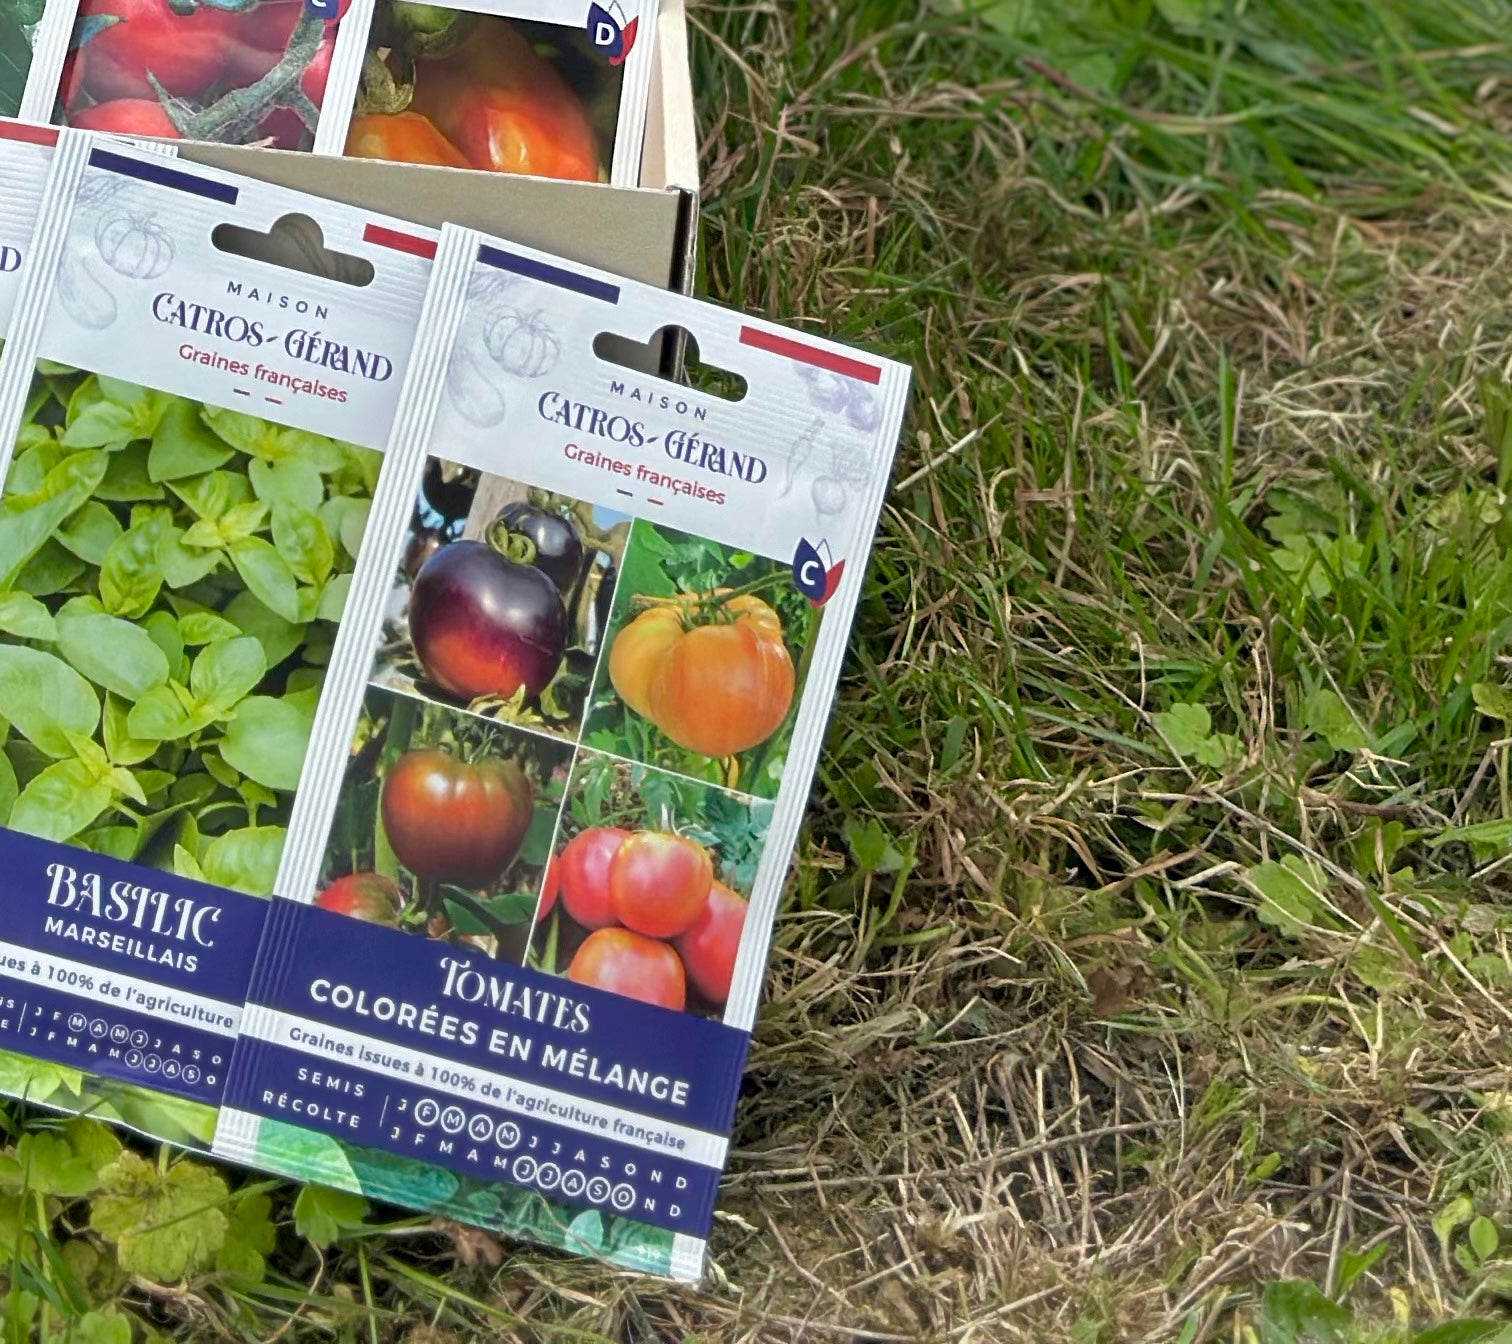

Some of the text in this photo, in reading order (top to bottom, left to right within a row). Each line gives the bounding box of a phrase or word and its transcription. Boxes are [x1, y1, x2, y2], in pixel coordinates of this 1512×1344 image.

[595, 22, 615, 46] D
[227, 281, 328, 319] MAISON
[179, 344, 348, 403] Graines françaises
[610, 381, 707, 421] MAISON
[564, 444, 726, 505] Graines françaises
[800, 560, 819, 585] C
[46, 863, 222, 947] BASILIC
[45, 916, 198, 972] MARSEILLAIS
[31, 961, 41, 976] à
[48, 965, 94, 990] 100%
[99, 981, 121, 997] de
[125, 987, 233, 1028] l'agriculture
[440, 957, 590, 1033] TOMATES
[310, 979, 689, 1105] COLORÉES EN MÉLANGE
[263, 1090, 360, 1128] RÉCOLTE
[289, 1027, 686, 1151] Graines issues à 100% de l'agriculture française
[298, 1068, 364, 1097] SEMIS
